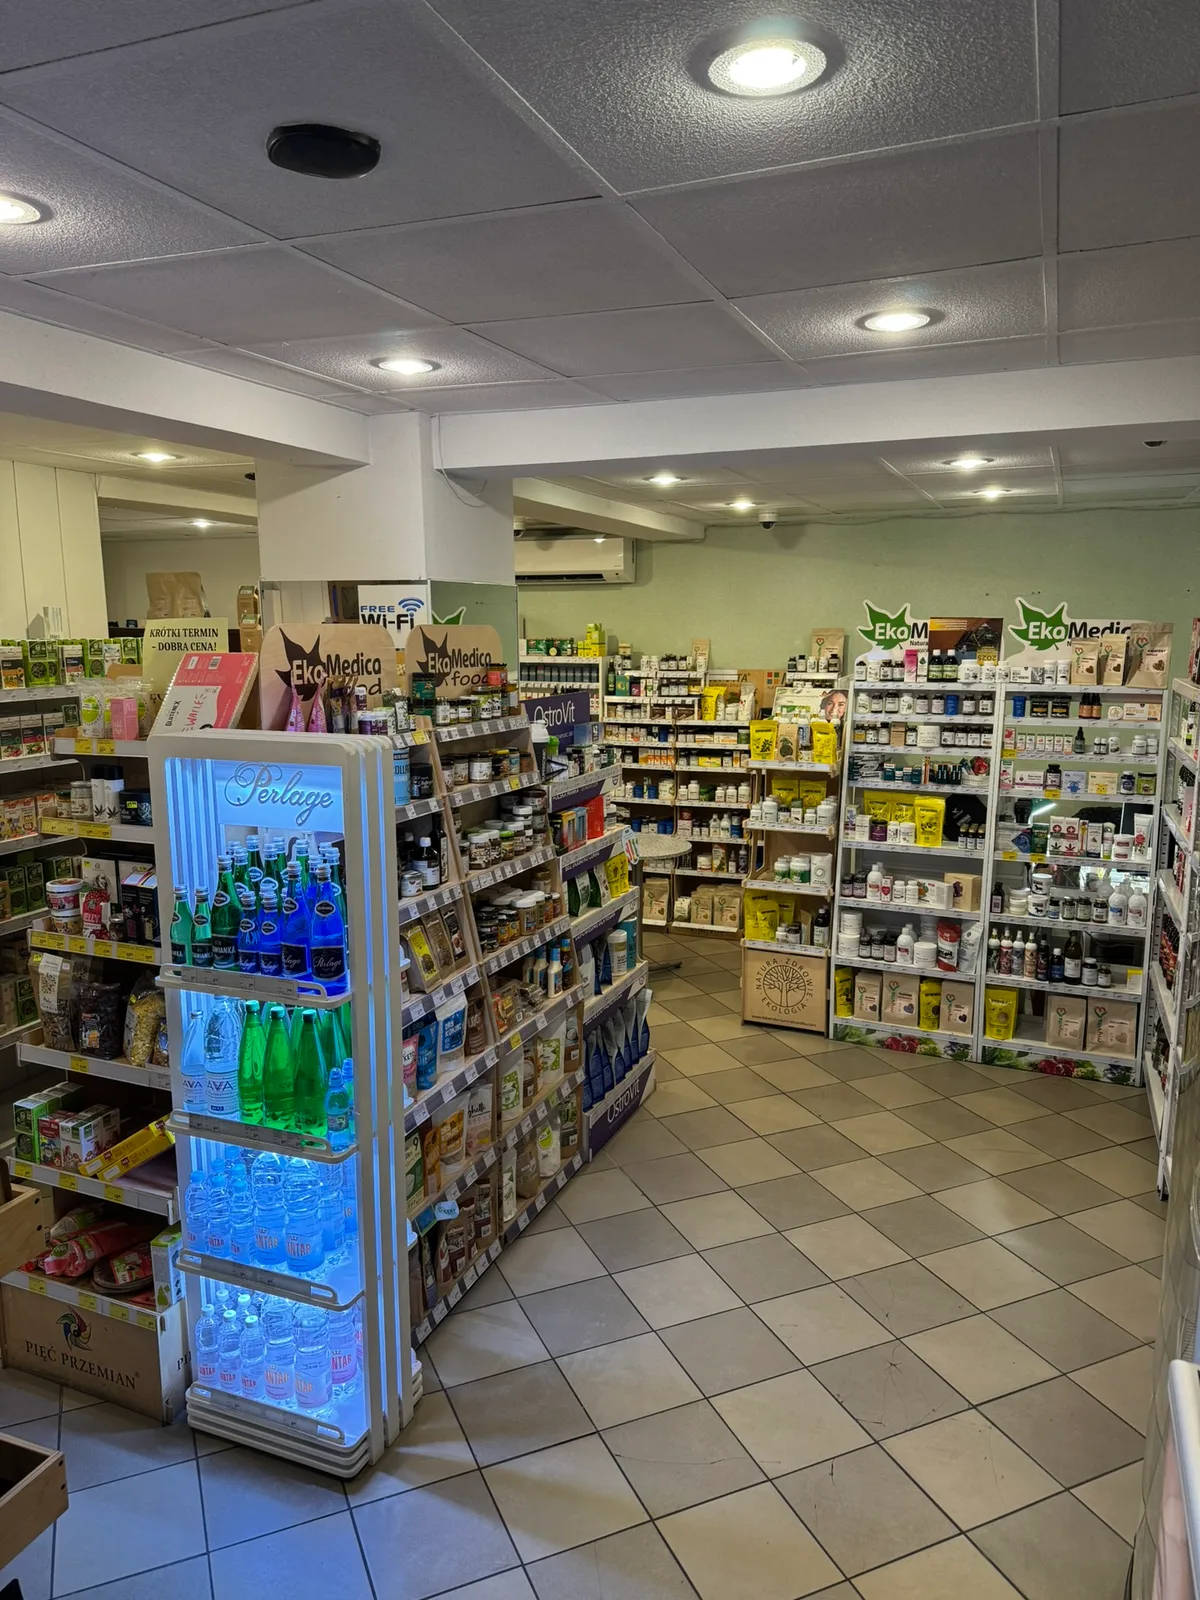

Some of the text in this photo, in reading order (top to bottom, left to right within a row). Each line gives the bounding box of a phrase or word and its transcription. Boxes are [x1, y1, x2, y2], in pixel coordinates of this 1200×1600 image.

[150, 627, 218, 637] KRÓTKI TERMIN
[361, 613, 415, 630] Wi-Fi
[158, 642, 188, 651] DOBRA
[190, 642, 217, 651] CENA!
[187, 700, 204, 726] WAFLE
[534, 700, 575, 726] OstroVit
[224, 761, 333, 826] Perlage
[756, 958, 778, 990] NATURA
[761, 996, 807, 1015] EKOLOGIA
[607, 1078, 640, 1123] OstroVit
[25, 1340, 136, 1389] PIĘĆ PRZEMIAN
[177, 1351, 191, 1371] PI
